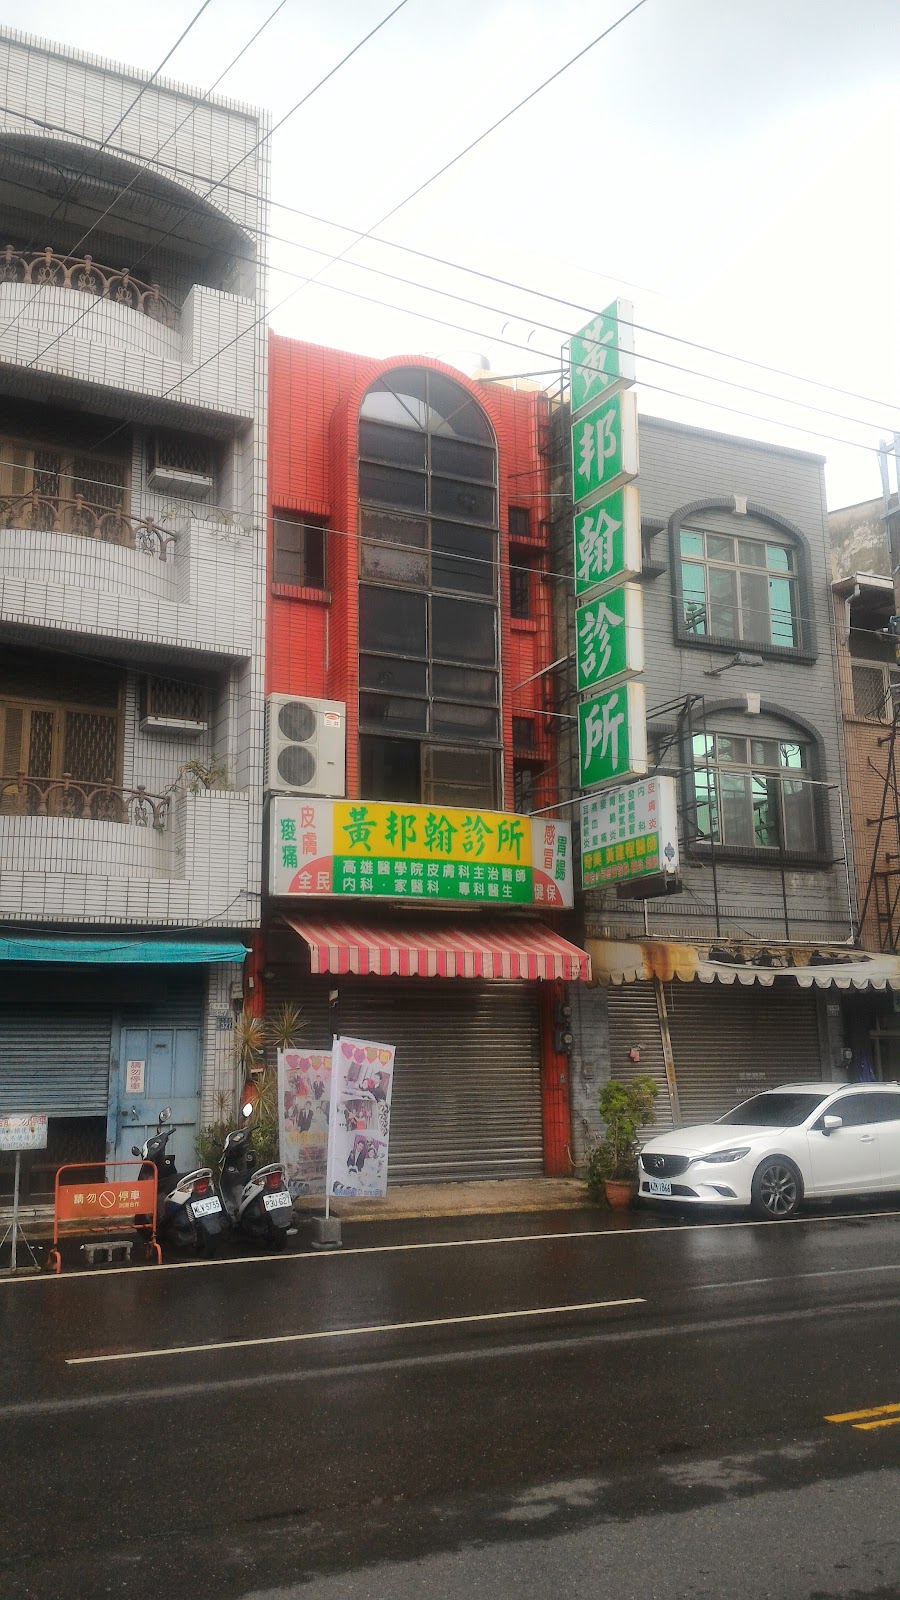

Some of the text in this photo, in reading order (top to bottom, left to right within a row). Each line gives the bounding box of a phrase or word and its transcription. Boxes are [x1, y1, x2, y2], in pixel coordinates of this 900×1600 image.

[576, 317, 625, 771] 黃邦翰診所
[280, 818, 298, 869] 痠痛
[300, 805, 318, 856] 皮膚
[342, 806, 525, 860] 黃邦翰診所
[543, 824, 556, 869] 感冒
[298, 870, 331, 890] 全民
[342, 859, 527, 883] 高雄醫學院皮膚科主治醫師
[554, 835, 568, 881] 胃腸
[534, 883, 557, 901] 健保
[130, 1061, 142, 1090] 請勿停車
[73, 1190, 141, 1204] 請勿 停車
